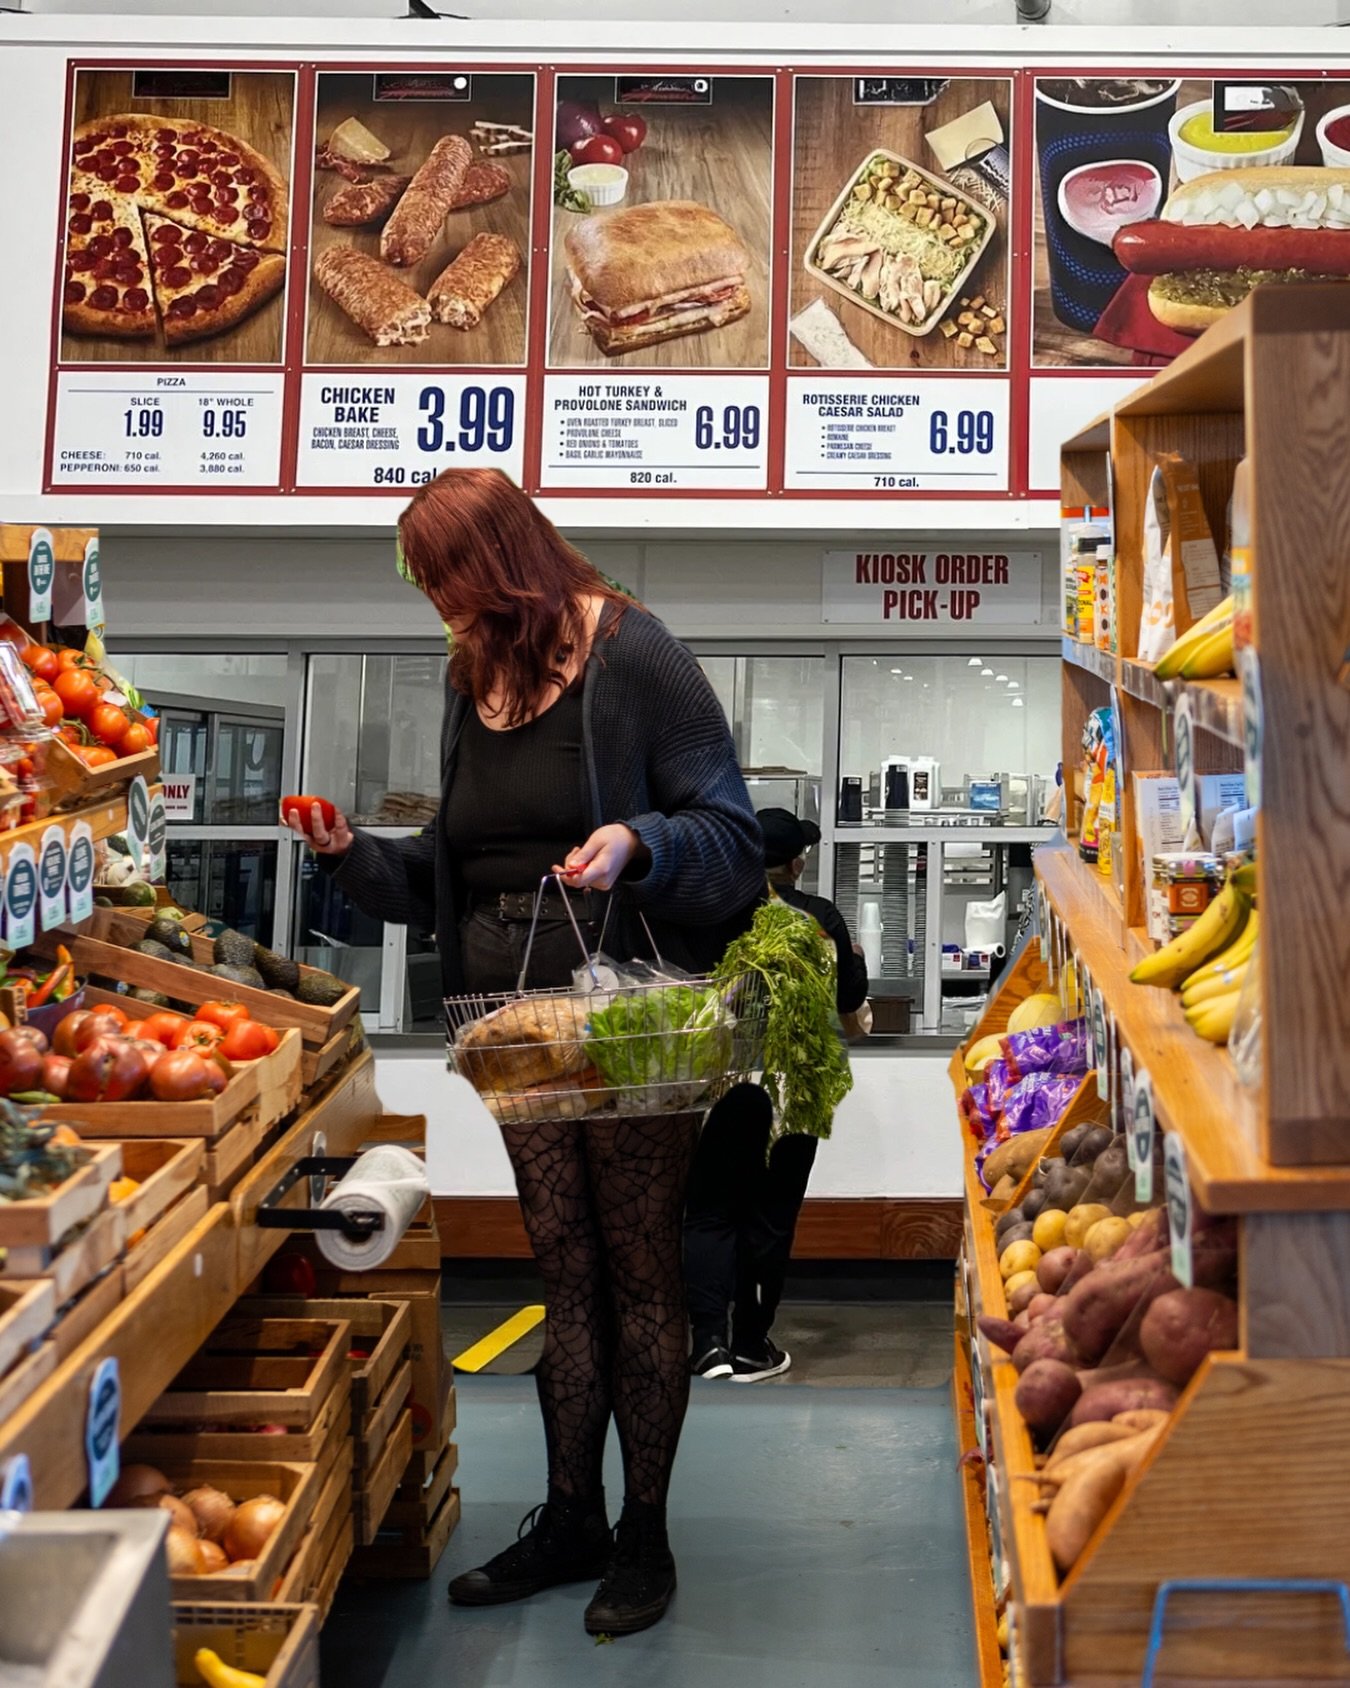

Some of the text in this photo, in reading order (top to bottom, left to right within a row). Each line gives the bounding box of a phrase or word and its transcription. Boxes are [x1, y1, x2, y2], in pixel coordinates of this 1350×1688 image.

[157, 378, 186, 386] PIZZA
[321, 387, 395, 404] CHICKEN
[579, 386, 662, 397] HOT TURKEY &
[131, 397, 159, 406] SLICE
[217, 398, 253, 406] WHOLE
[803, 394, 919, 405] ROTISSERIE CHICKEN
[555, 400, 686, 411] PROVOLONE SANDWICH
[335, 407, 379, 423] BAKE
[819, 407, 903, 417] CAESAR SALAD
[124, 410, 163, 437] 1.99
[203, 410, 246, 437] 9.95
[417, 387, 514, 452] 3.99
[313, 427, 341, 437] CHICKEN
[696, 406, 760, 449] 6.99
[930, 411, 993, 454] 6.99
[338, 439, 364, 449] CAESAR
[366, 440, 399, 450] DRESSING
[61, 451, 105, 460] CHEESE:
[145, 452, 161, 460] cal.
[201, 452, 245, 460] 4,260 cal.
[60, 464, 121, 473] PEPPERONI:
[124, 464, 160, 473] 650 cal.
[228, 465, 244, 473] cal.
[374, 467, 405, 483] 840
[630, 472, 676, 483] 820 cal.
[874, 477, 919, 487] 710 cal.
[856, 554, 1008, 584] KIOSK ORDER
[884, 590, 980, 620] PICK-UP
